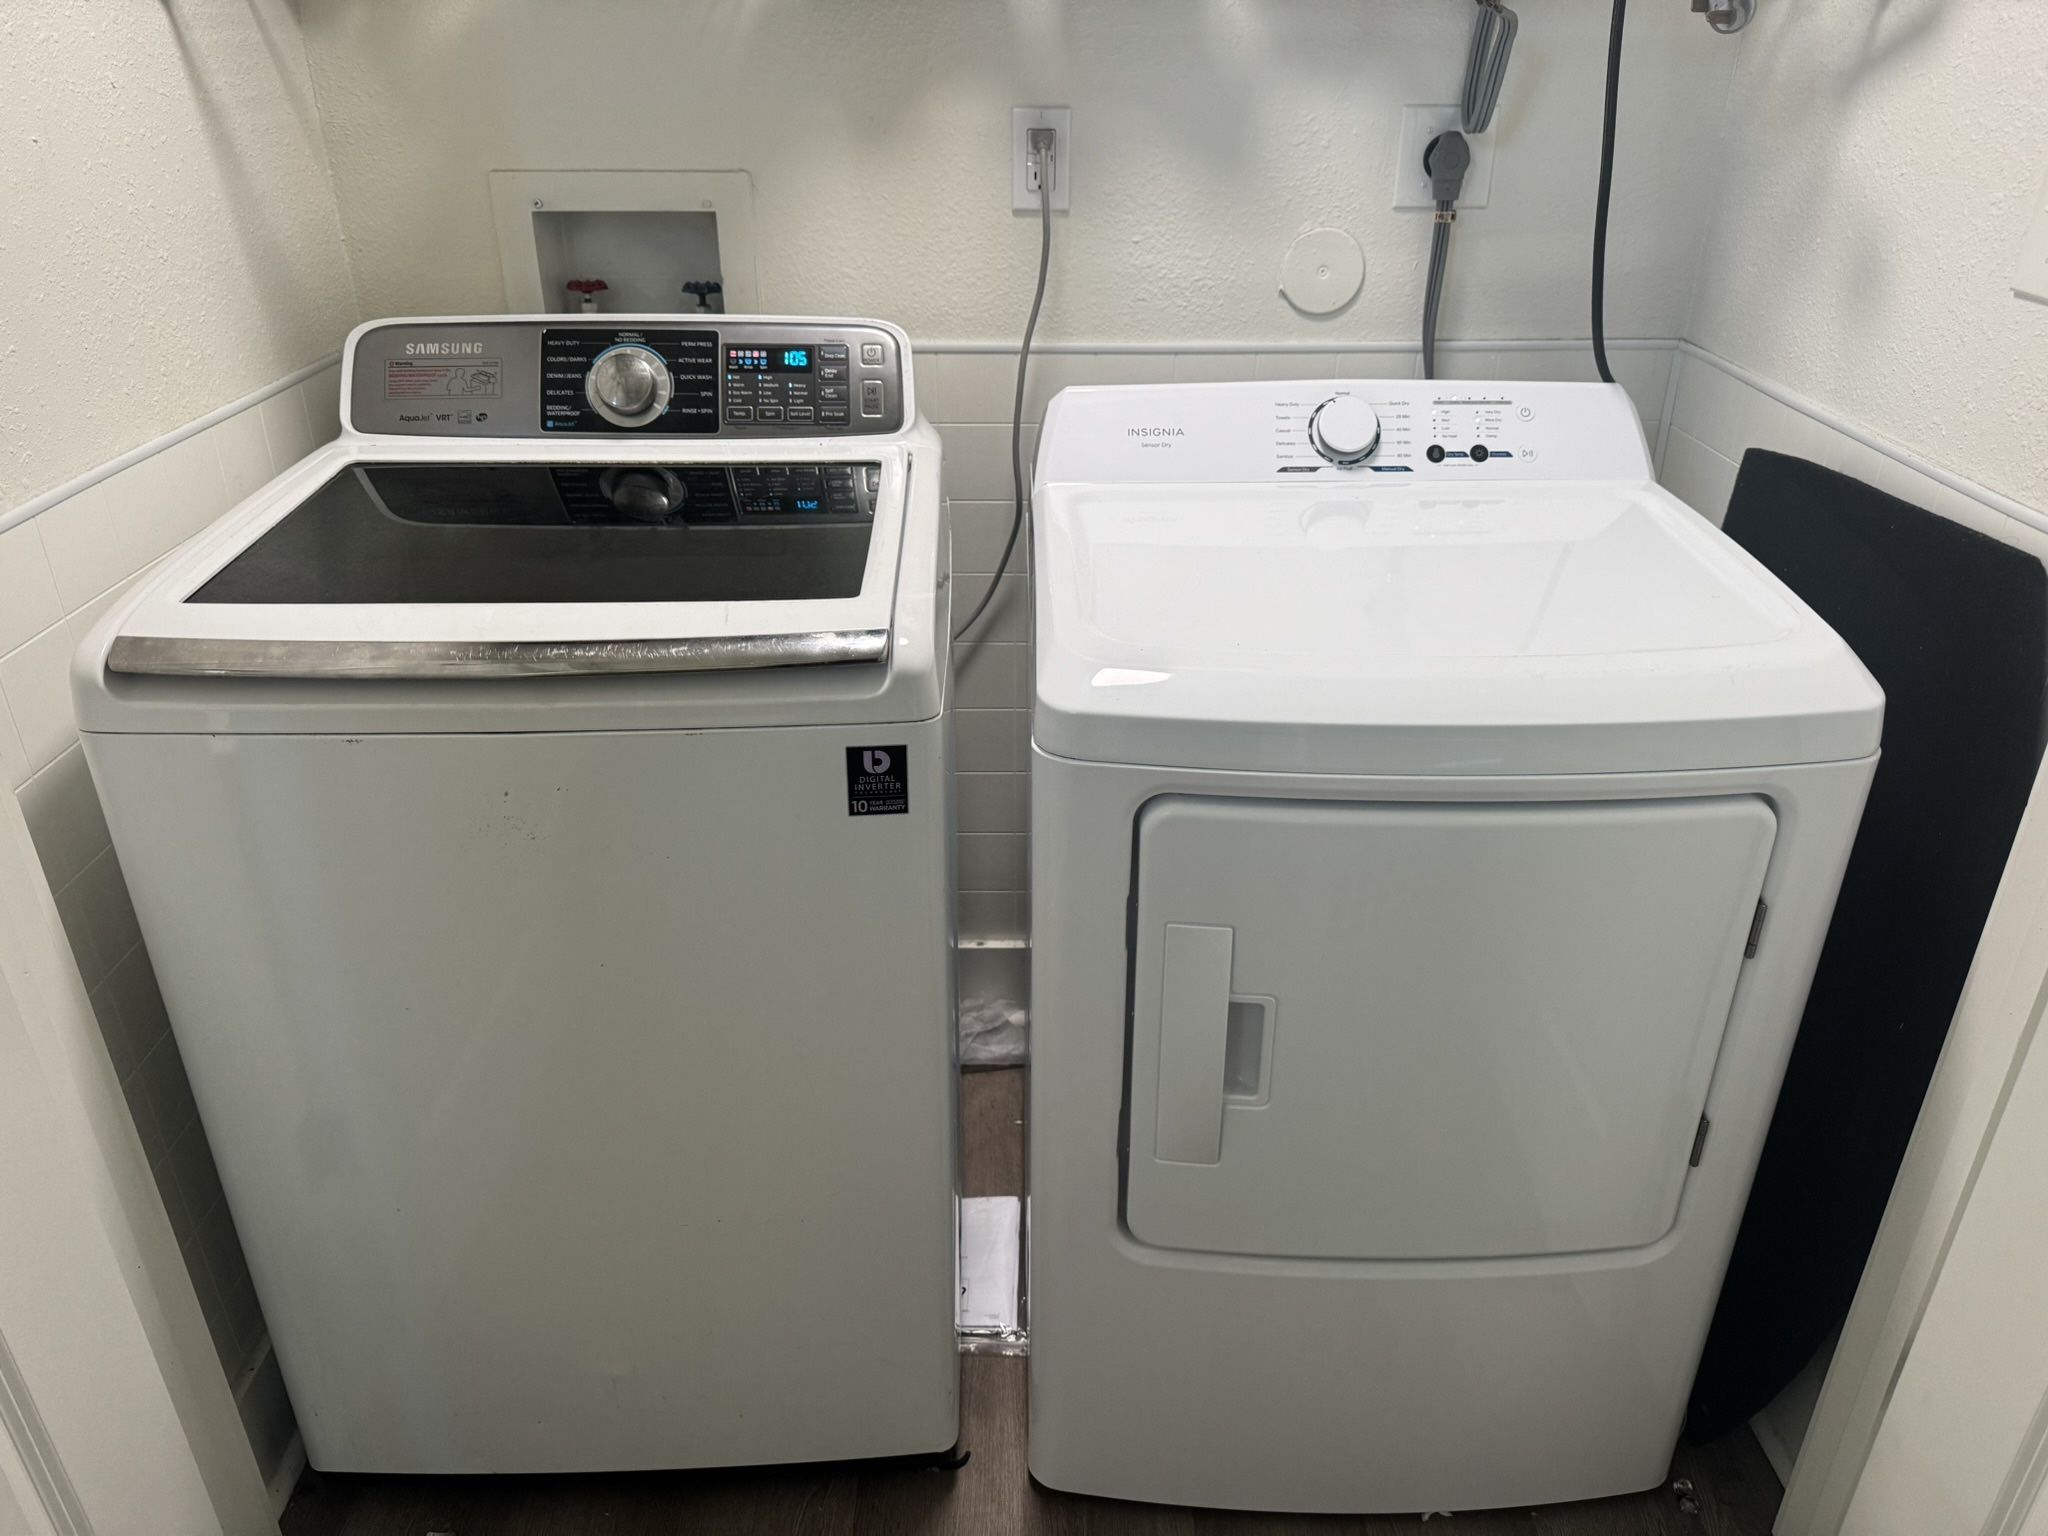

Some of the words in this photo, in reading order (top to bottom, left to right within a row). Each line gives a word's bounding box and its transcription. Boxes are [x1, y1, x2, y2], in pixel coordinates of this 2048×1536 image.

[405, 342, 483, 355] SAMSUNG
[784, 350, 807, 366] 105
[1127, 428, 1185, 437] INSIGNIA
[859, 775, 895, 784] DIGITAL
[854, 782, 901, 791] INVERTER
[851, 800, 868, 813] 10
